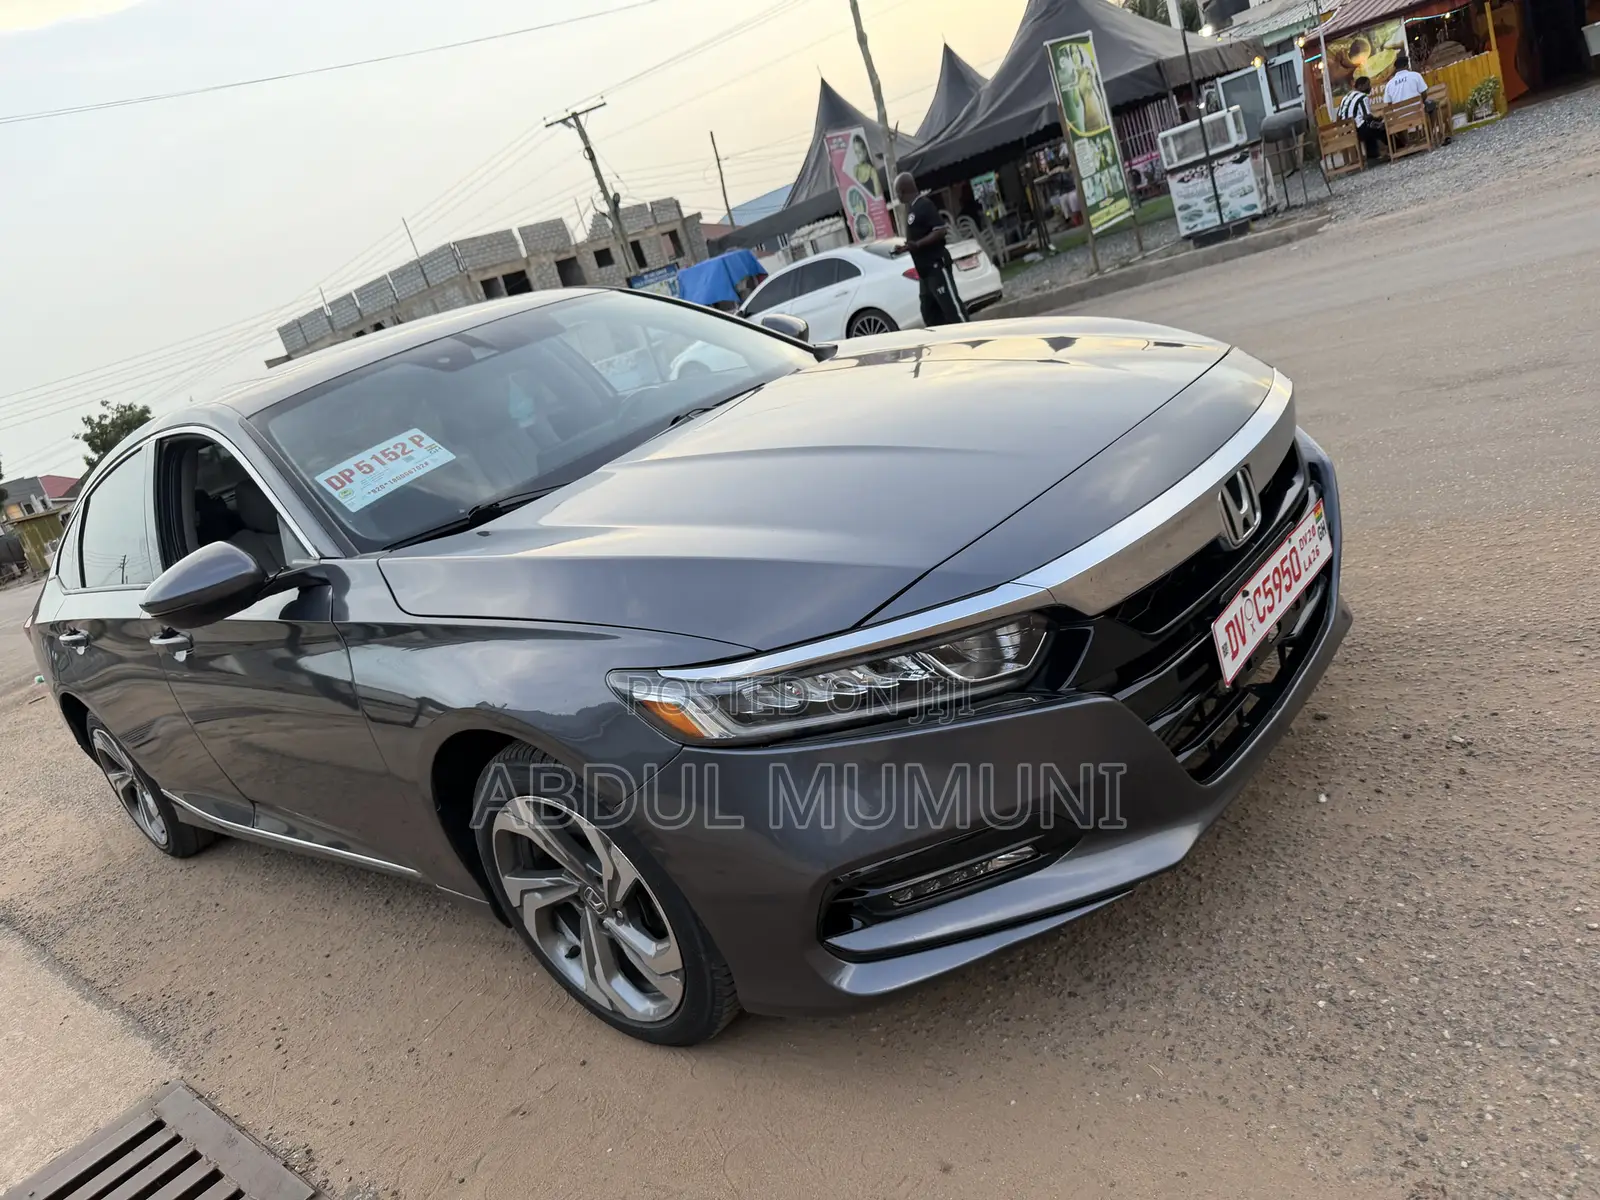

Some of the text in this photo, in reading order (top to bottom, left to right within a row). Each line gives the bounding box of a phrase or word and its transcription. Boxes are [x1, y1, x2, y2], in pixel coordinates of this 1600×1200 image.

[324, 469, 355, 491] DP
[408, 434, 424, 448] P
[1317, 519, 1327, 541] GH
[1303, 544, 1320, 572] LA26
[1224, 545, 1302, 662] DV C5950
